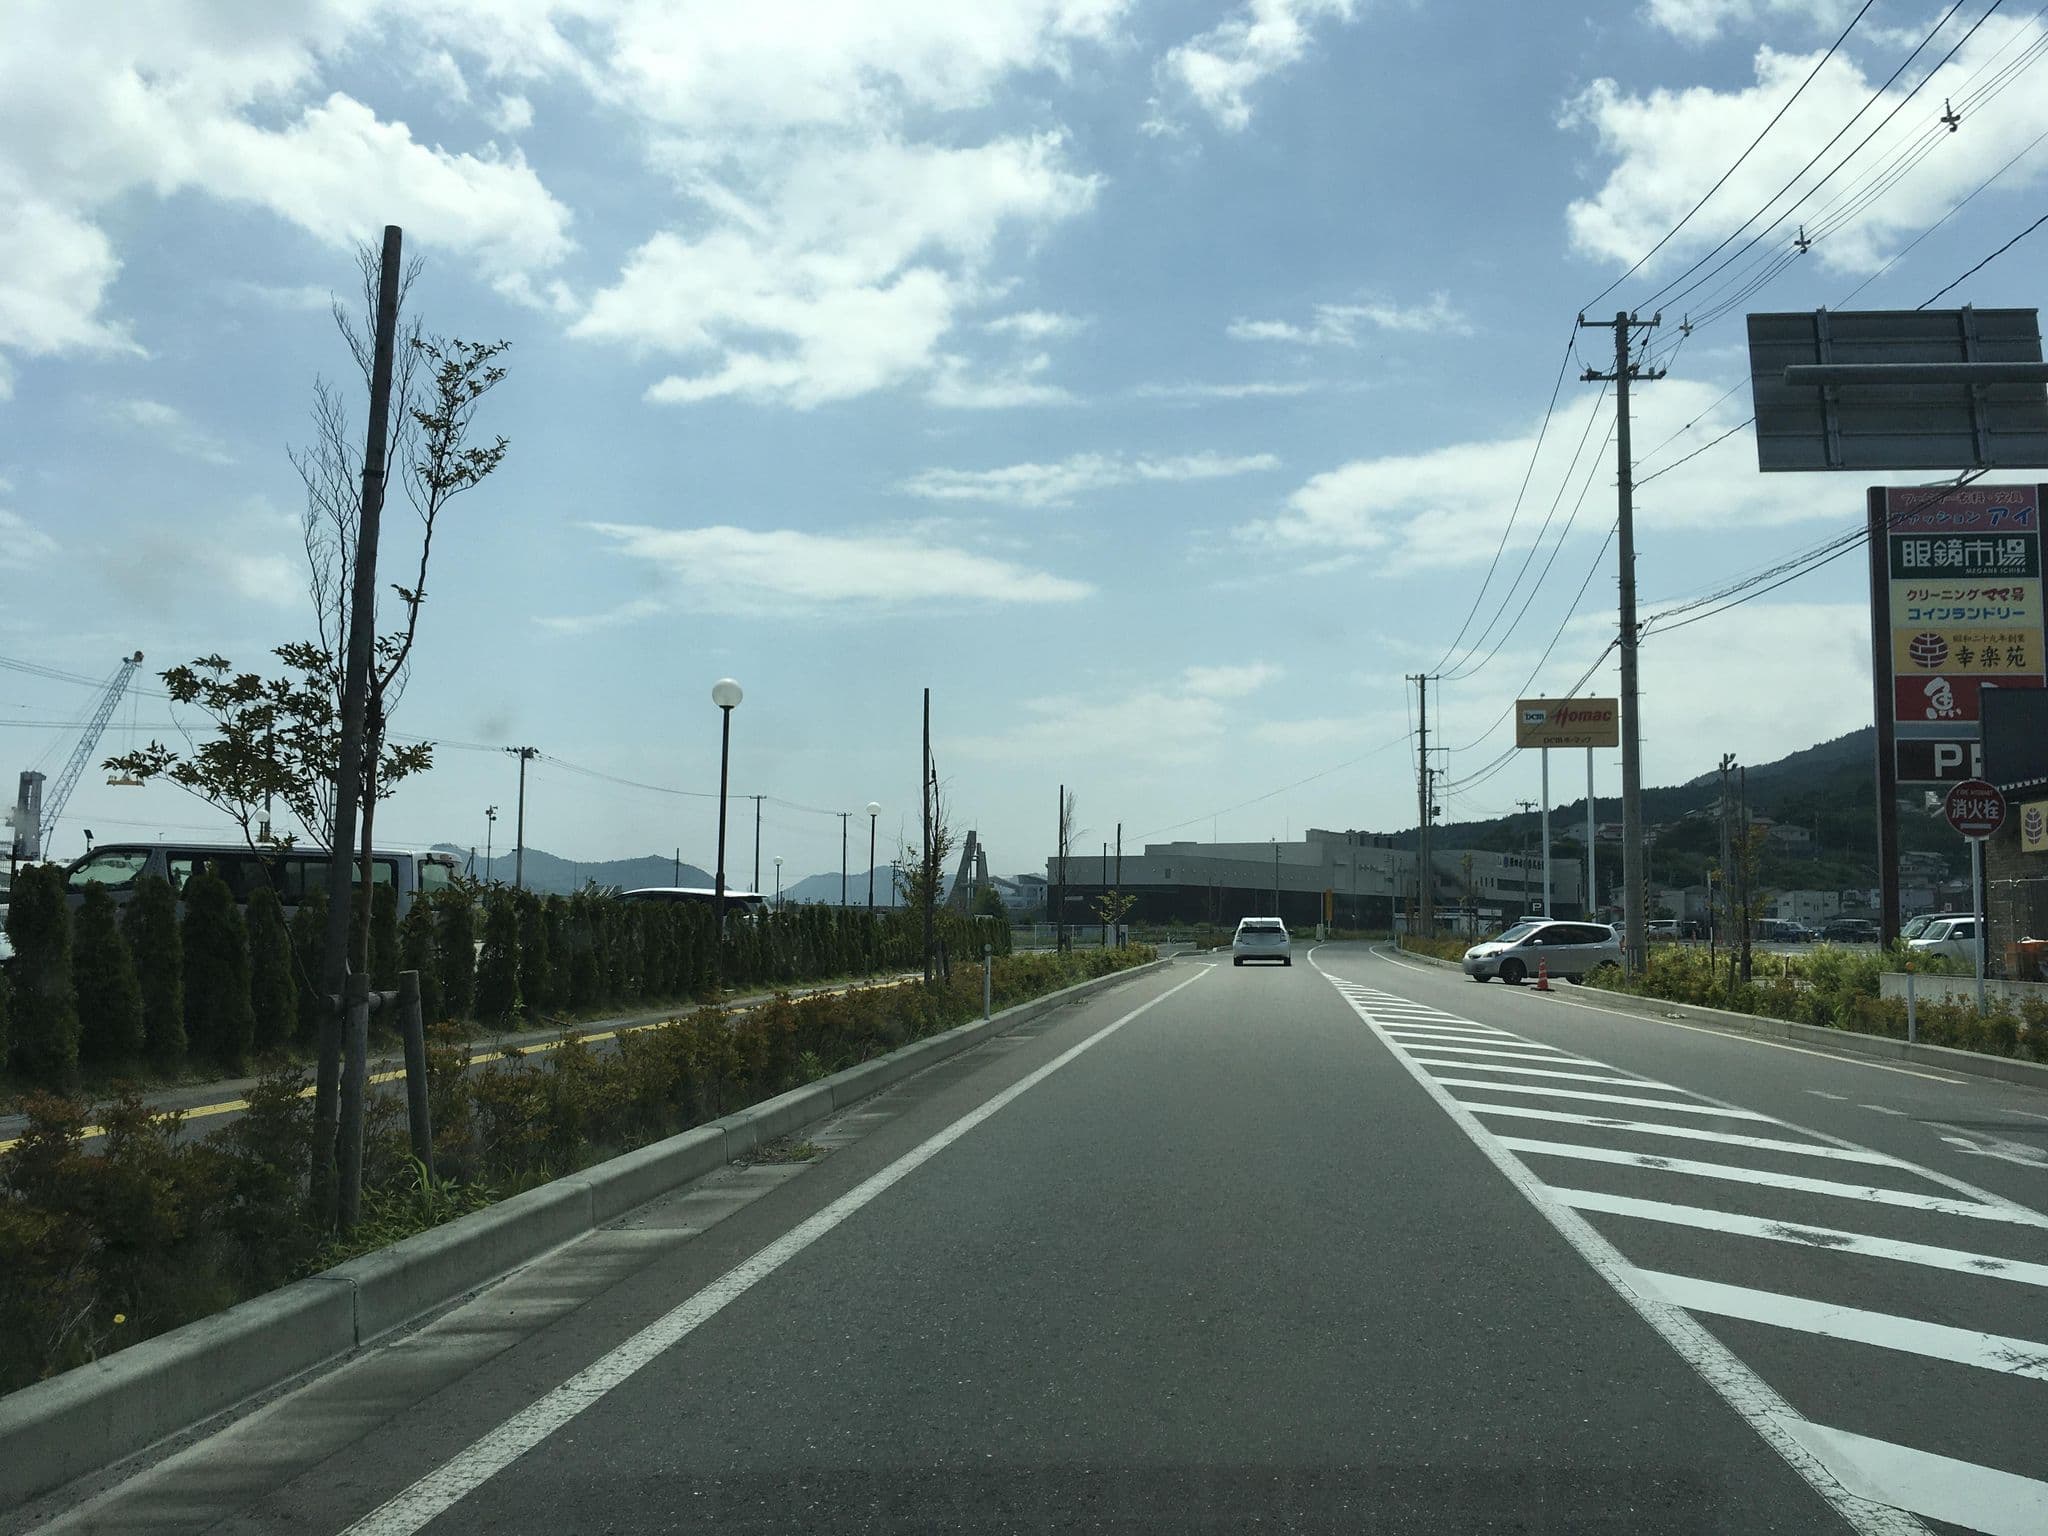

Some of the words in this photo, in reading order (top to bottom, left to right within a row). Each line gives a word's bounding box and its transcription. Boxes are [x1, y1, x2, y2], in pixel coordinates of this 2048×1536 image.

[1902, 539, 2026, 567] 眼鏡市場
[1908, 608, 2026, 620] コインランドリー
[1955, 646, 2026, 668] 幸楽苑
[1550, 707, 1613, 728] Homac
[1952, 798, 2000, 819] 消火栓
